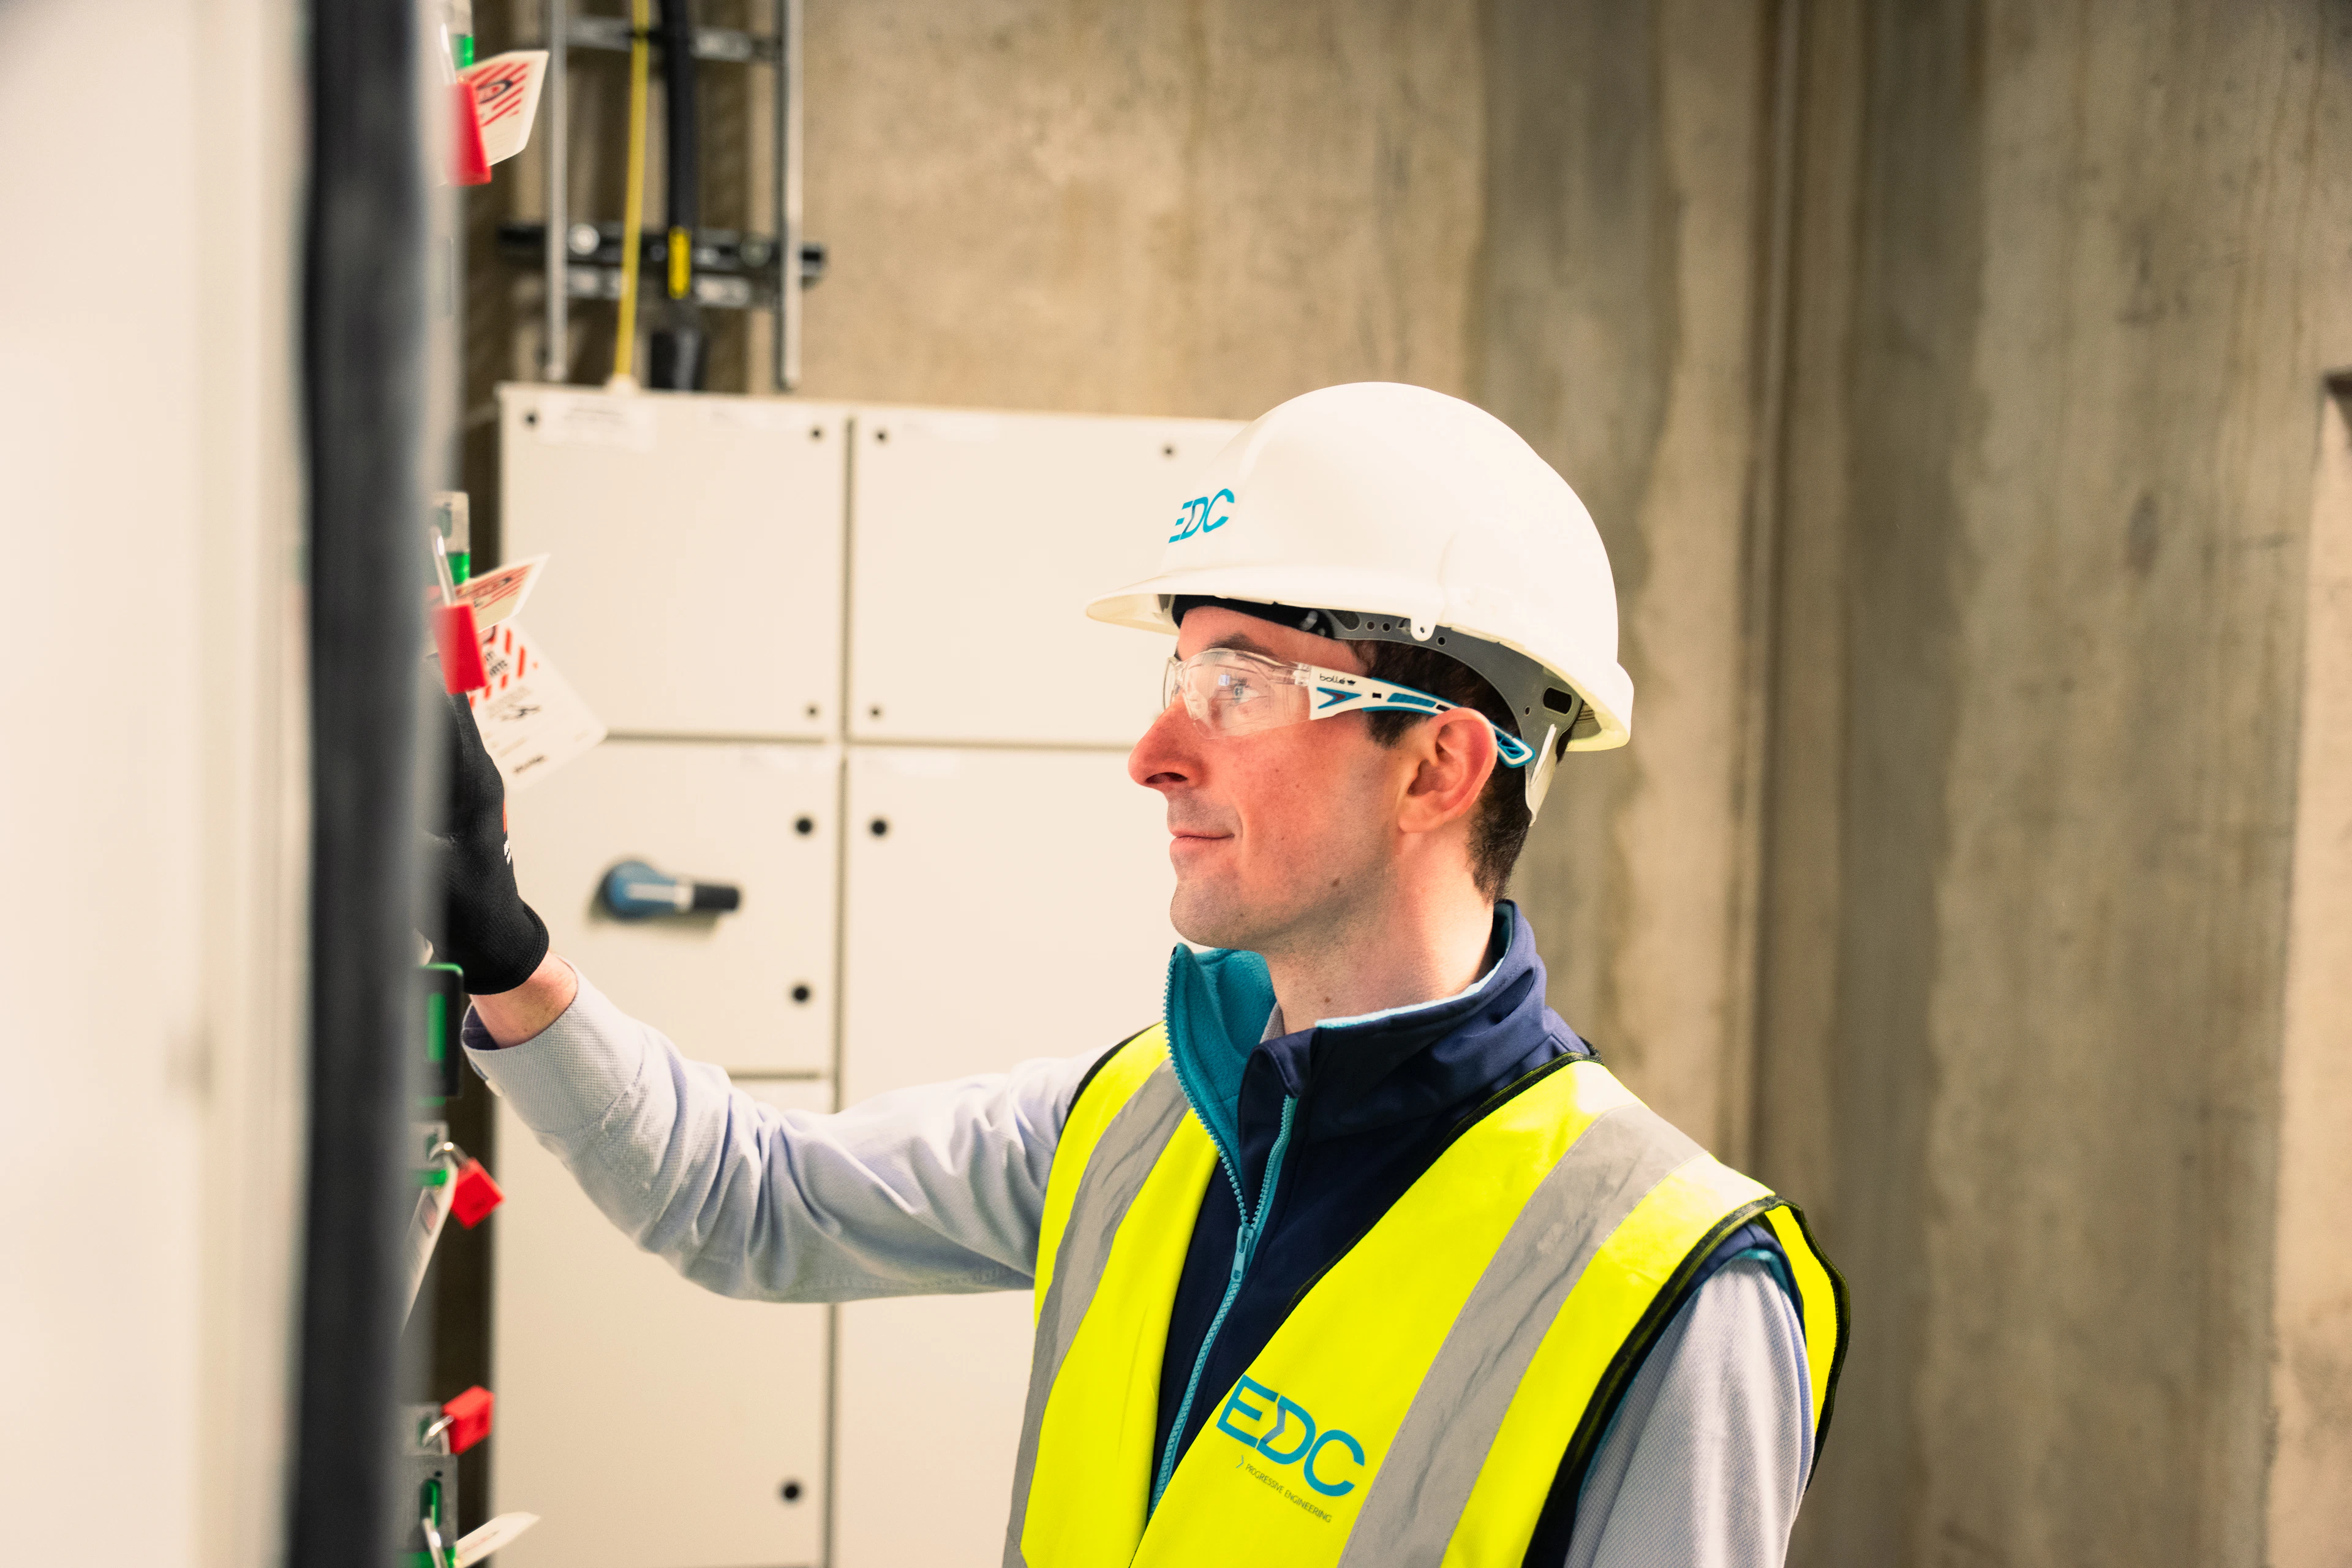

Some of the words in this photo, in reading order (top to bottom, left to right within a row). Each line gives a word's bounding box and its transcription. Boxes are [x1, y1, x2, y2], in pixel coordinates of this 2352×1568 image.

[1168, 488, 1235, 543] EDC
[1319, 673, 1346, 685] bollé
[1216, 1374, 1365, 1496] EDC
[1245, 1463, 1285, 1494] PROGRESSIVE
[1284, 1489, 1333, 1523] ENGINEERING
